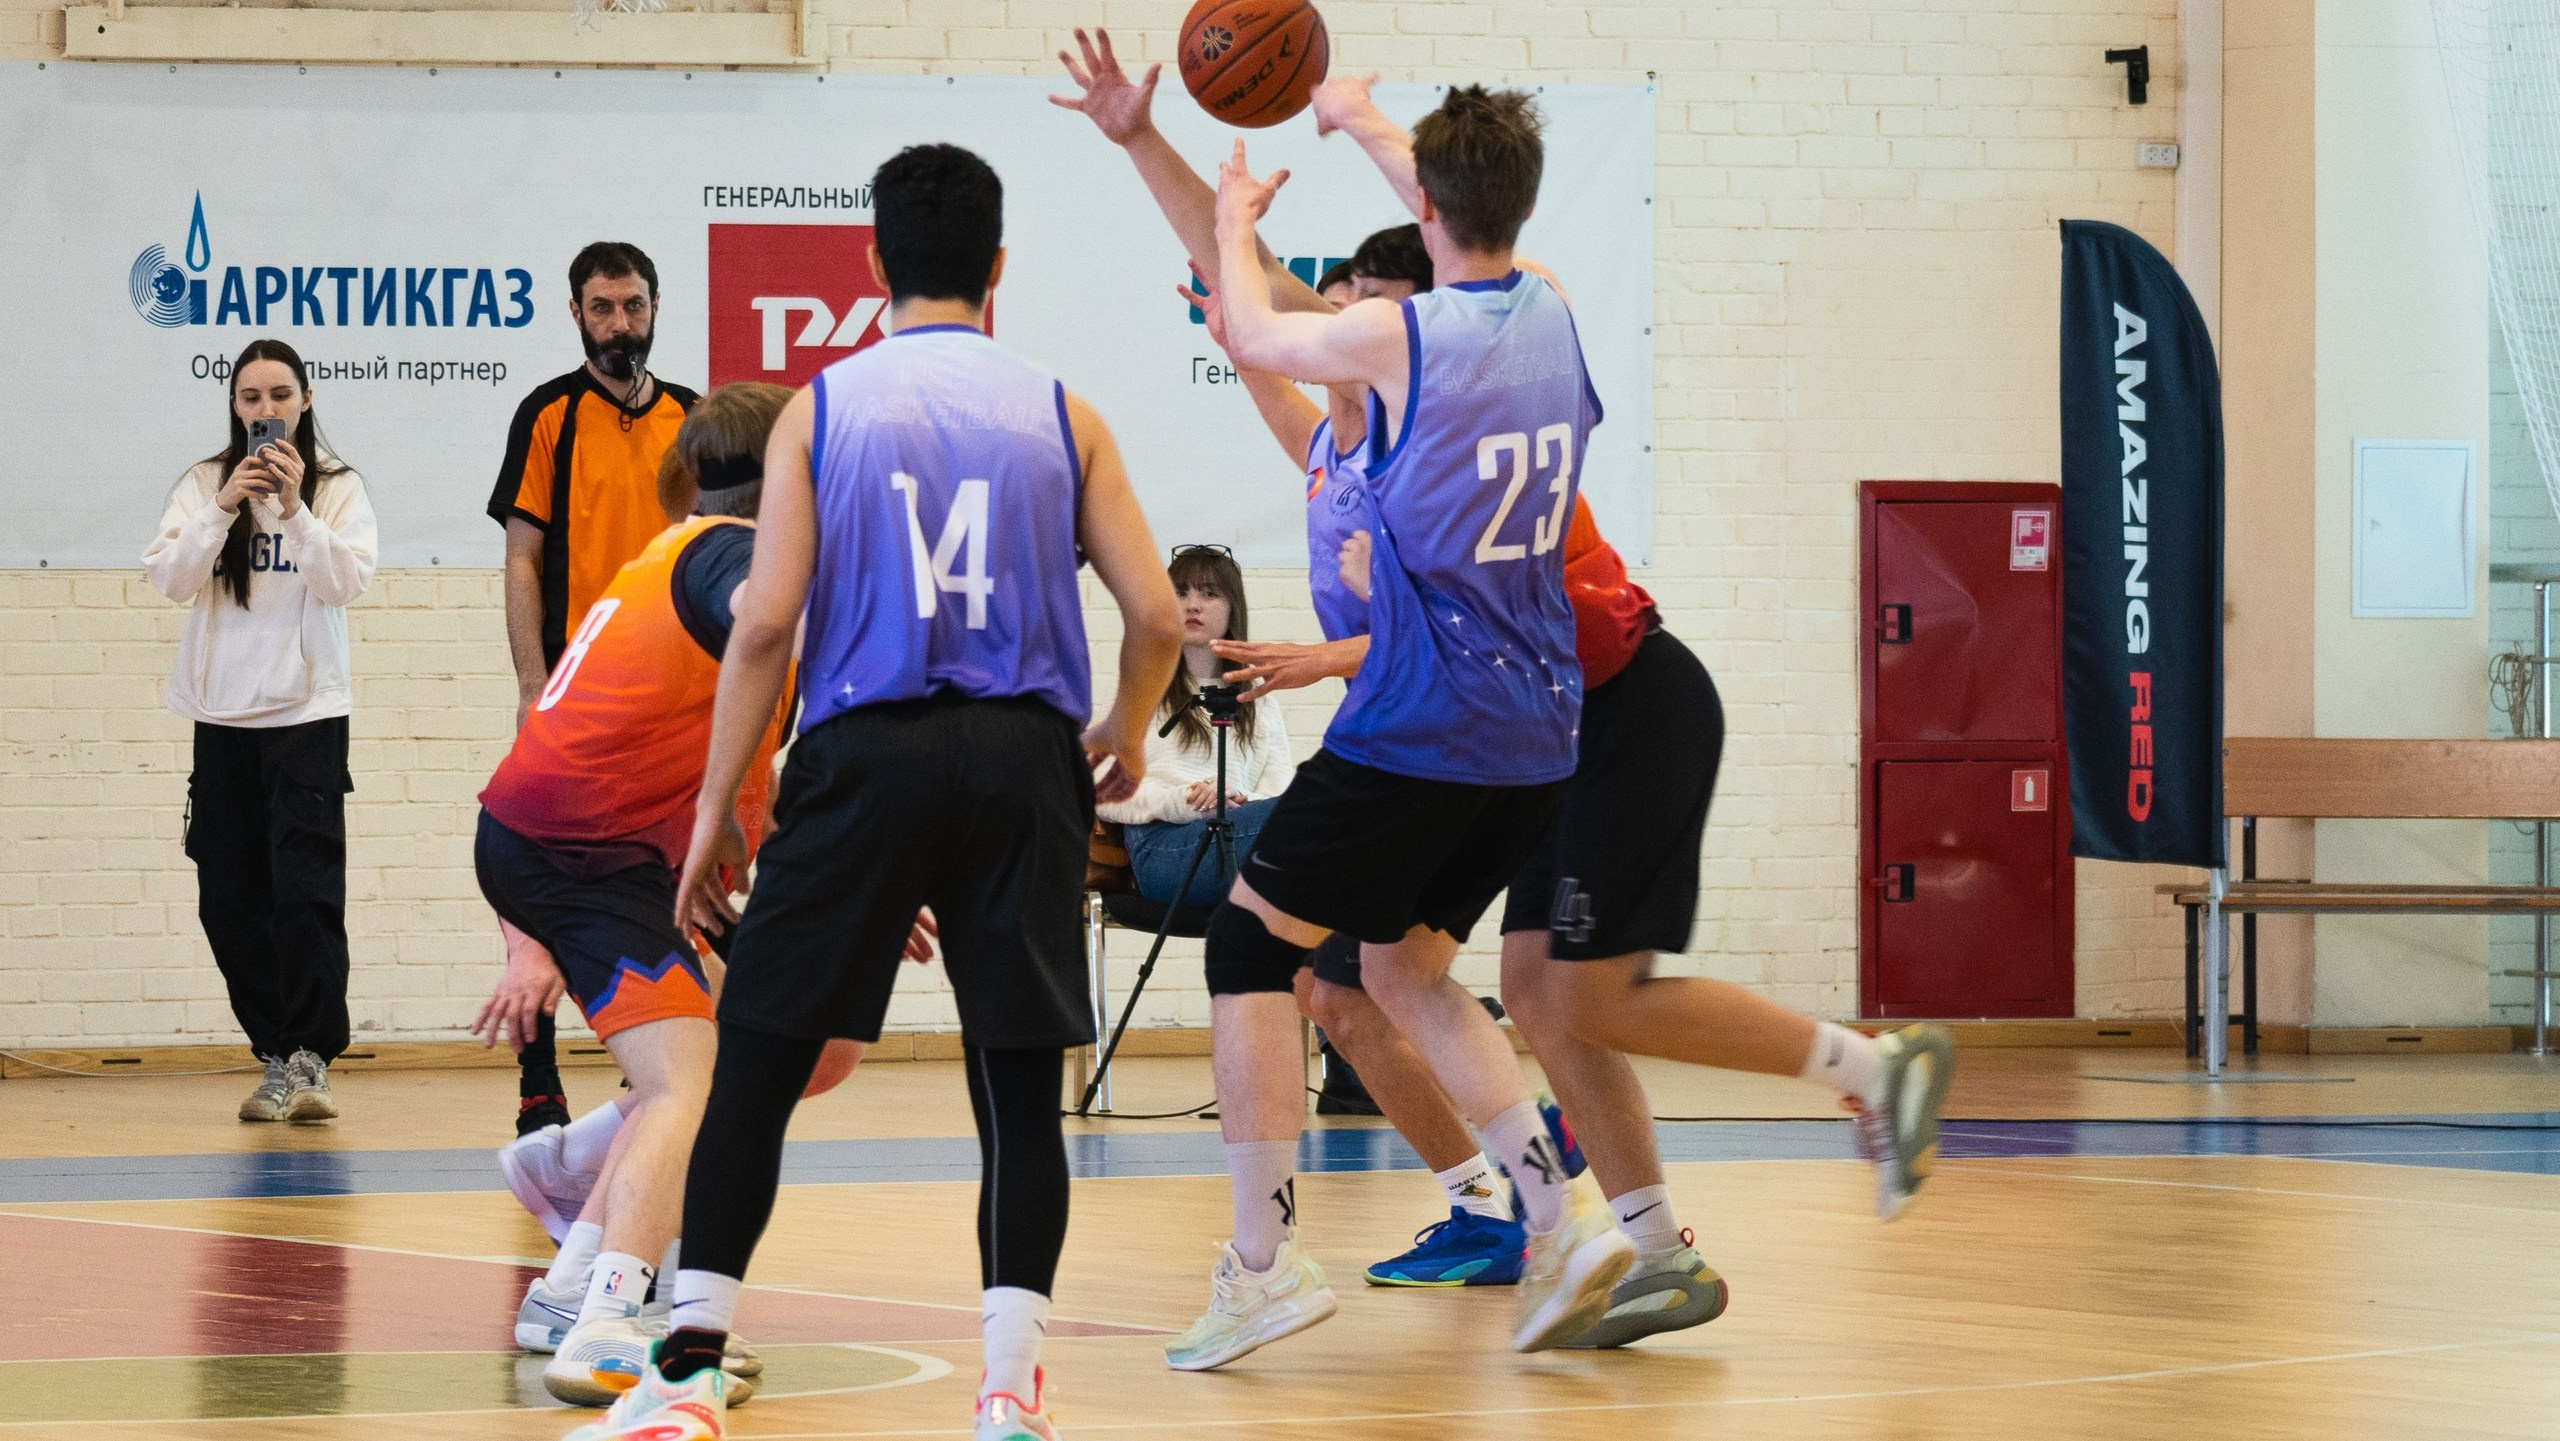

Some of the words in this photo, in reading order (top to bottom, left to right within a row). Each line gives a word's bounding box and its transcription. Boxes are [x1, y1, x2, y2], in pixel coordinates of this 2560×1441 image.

[703, 183, 876, 209] ГЕНЕРАЛЬНЫЙ
[215, 265, 535, 329] АРКТИКГАЗ
[191, 353, 388, 385] Офльный
[398, 356, 508, 387] партнер
[1474, 421, 1573, 565] 23
[2113, 301, 2151, 655] AMAZING
[890, 470, 995, 631] 14
[2127, 671, 2153, 824] RED
